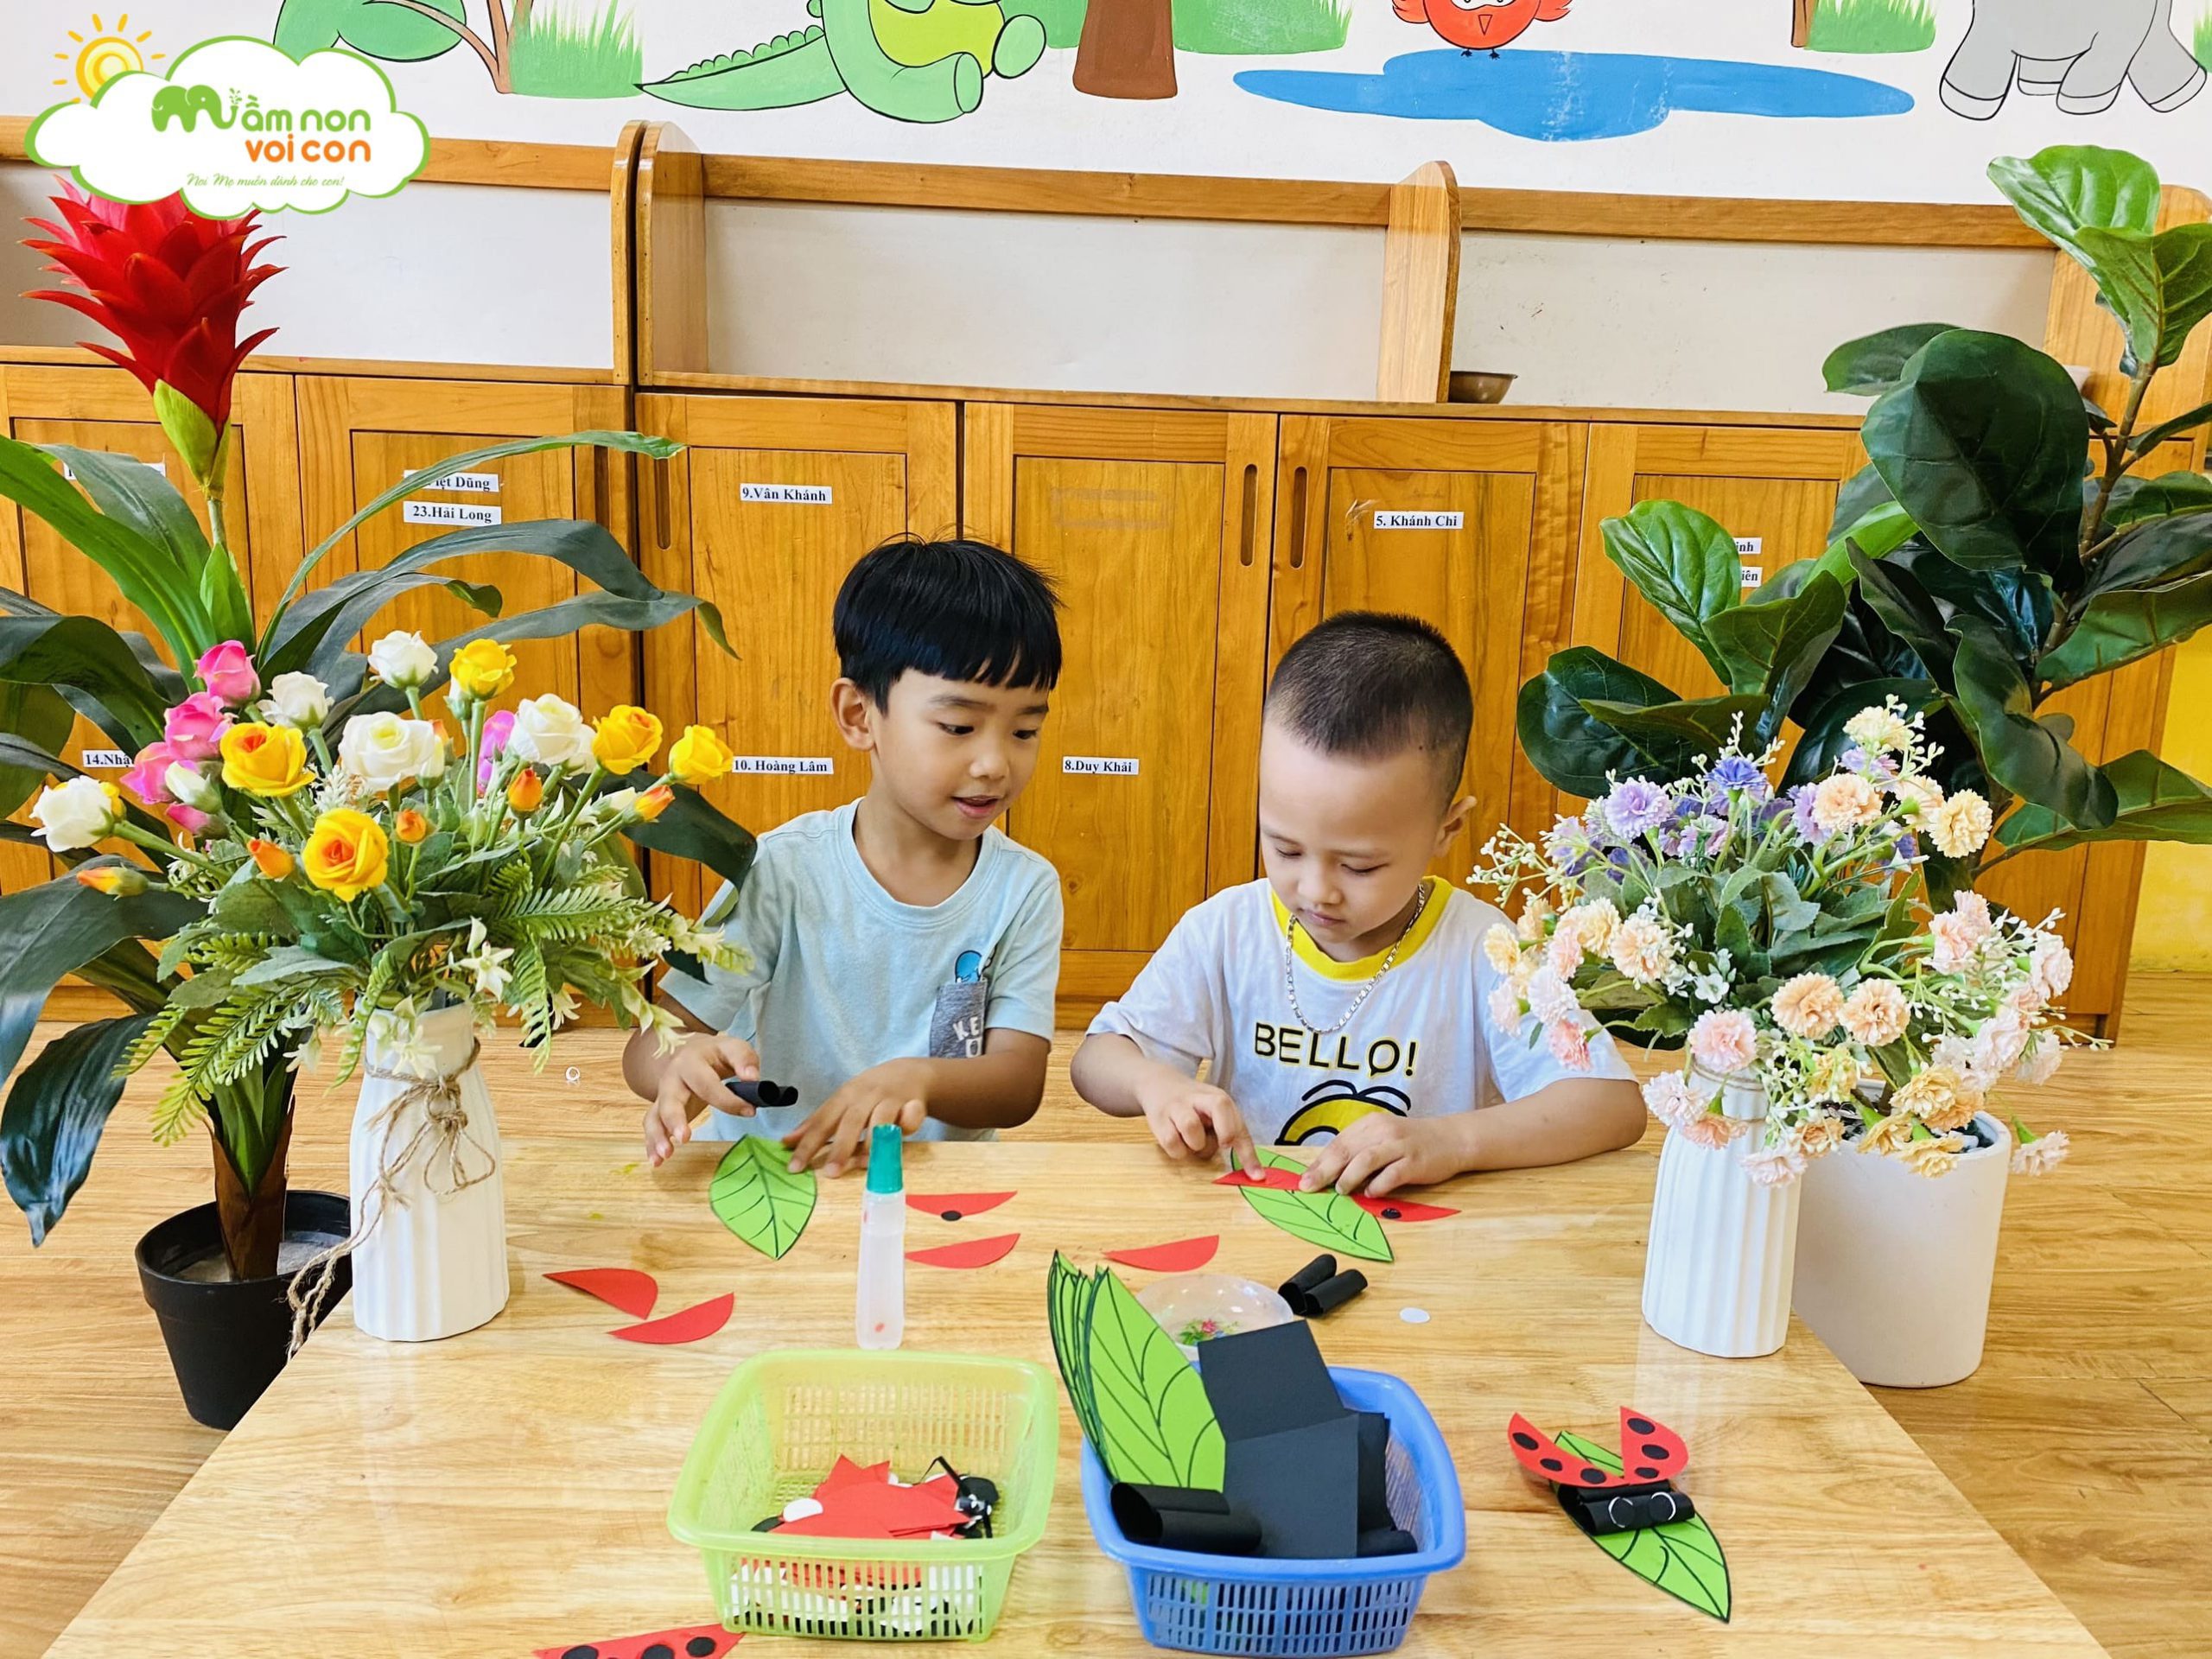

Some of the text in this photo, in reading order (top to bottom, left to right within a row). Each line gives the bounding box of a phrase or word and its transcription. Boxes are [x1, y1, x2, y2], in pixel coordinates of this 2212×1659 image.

[455, 476, 490, 492] Dũng
[742, 487, 826, 501] 9.Vân Khánh
[460, 508, 492, 524] Long
[1376, 515, 1457, 526] 5. Khánh Chi
[1736, 542, 1754, 552] inh
[1741, 570, 1758, 581] iên
[734, 760, 827, 774] 10. Hoàng Lâm
[1065, 760, 1099, 774] 8.Duy
[1255, 1022, 1417, 1077] BELLO!
